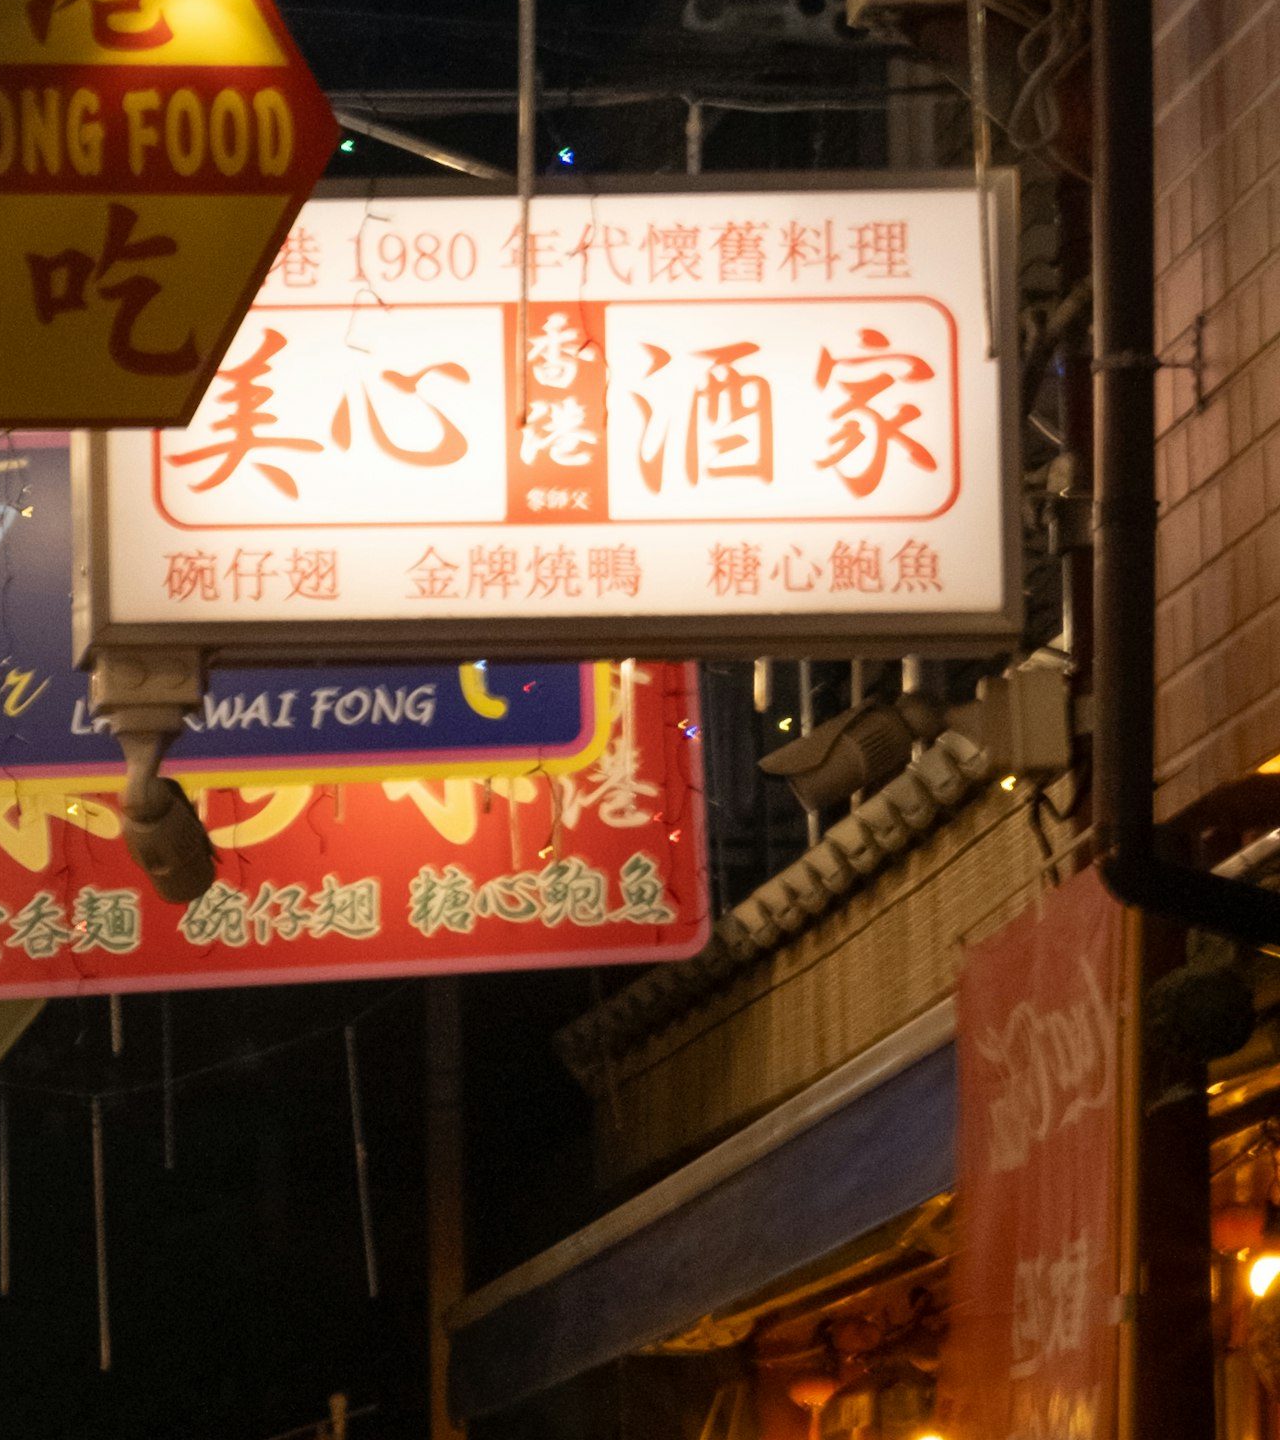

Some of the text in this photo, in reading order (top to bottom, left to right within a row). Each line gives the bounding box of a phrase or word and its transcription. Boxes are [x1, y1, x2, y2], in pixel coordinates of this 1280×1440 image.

[122, 86, 296, 177] FOOD
[350, 232, 477, 282] 1980
[165, 328, 939, 501] 美心 酒家
[520, 312, 598, 468] 香港
[162, 537, 946, 604] 碗仔翅 金牌燒鴨 糖心鮑魚
[311, 683, 436, 729] FONG
[178, 874, 381, 947] 碗仔翅
[407, 853, 675, 935] 糖心鮑魚
